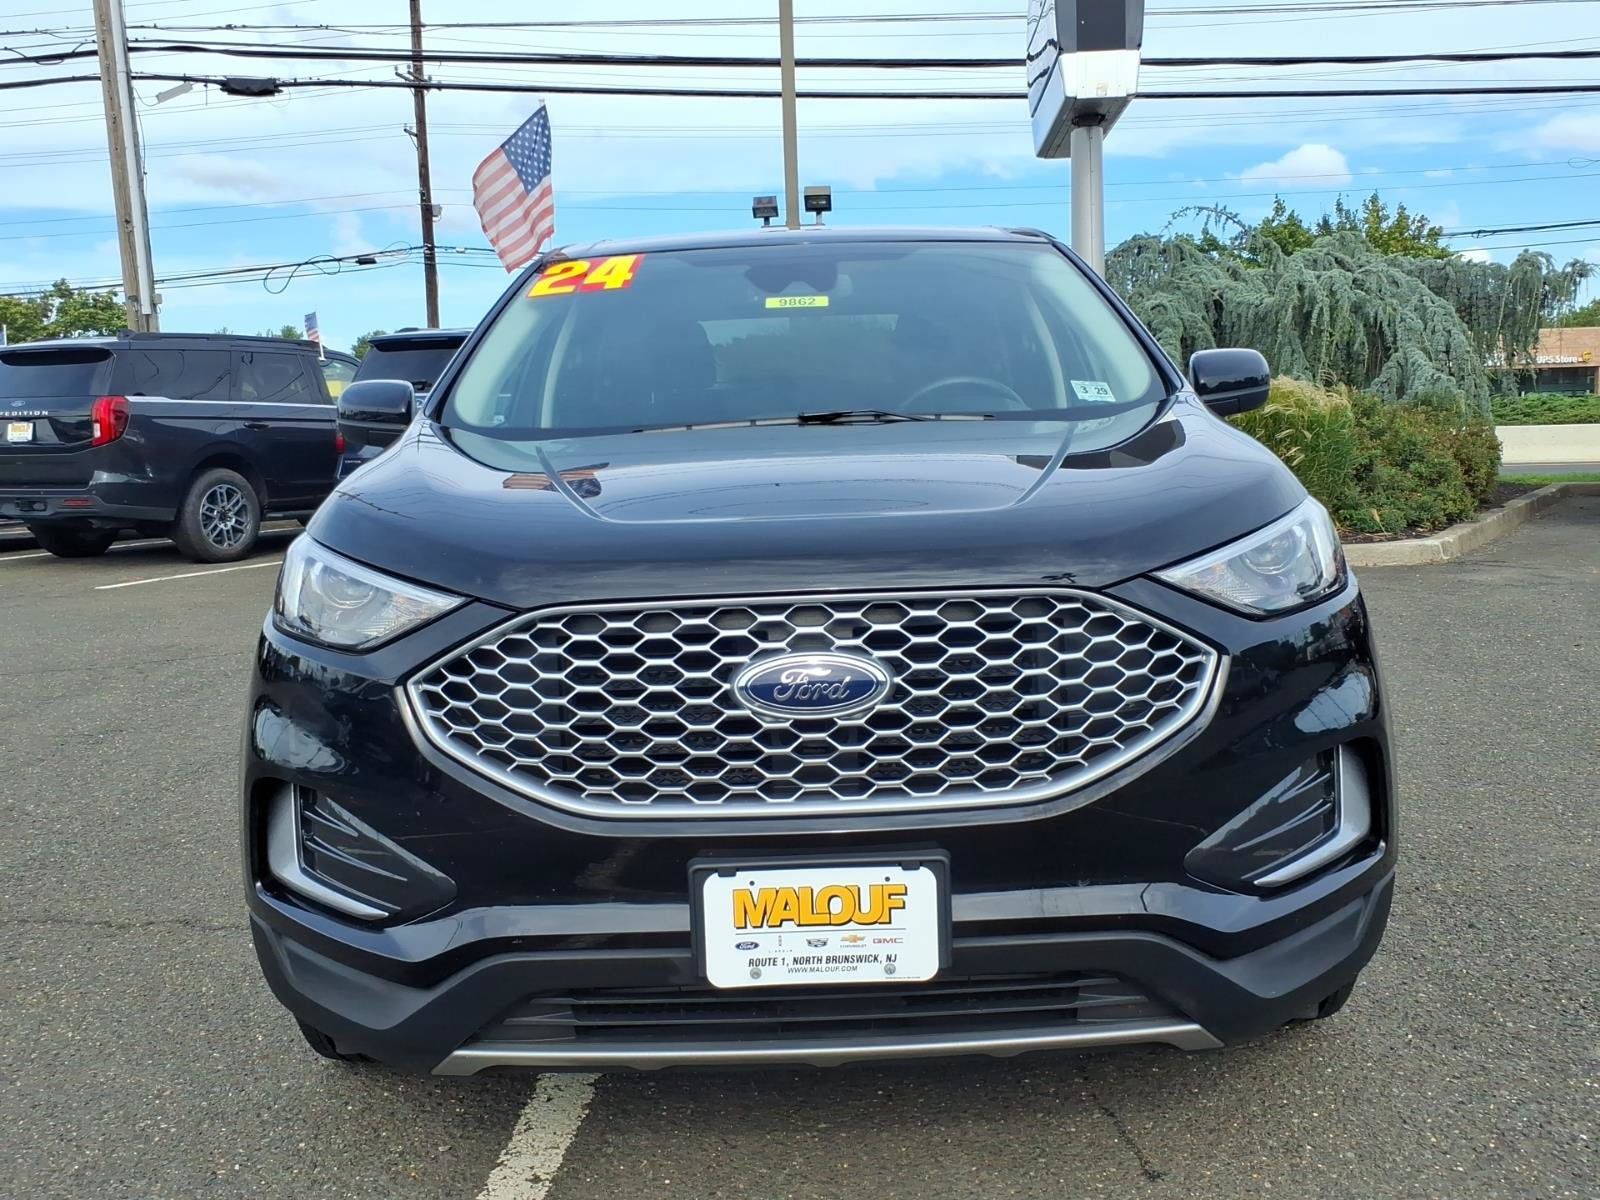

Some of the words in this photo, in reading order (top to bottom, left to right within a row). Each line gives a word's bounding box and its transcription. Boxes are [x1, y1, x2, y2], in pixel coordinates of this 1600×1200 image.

[528, 255, 638, 297] 24
[778, 297, 817, 306] 9862
[1554, 355, 1577, 363] Store
[773, 667, 851, 700] Ford
[733, 884, 908, 929] MALOUF
[748, 957, 778, 967] ROUTE
[781, 957, 789, 967] 1,
[793, 955, 823, 965] NORTH
[825, 953, 883, 964] BRUNSWICK,
[886, 953, 898, 963] NJ
[787, 965, 858, 973] WWW.MALOUF.COM
